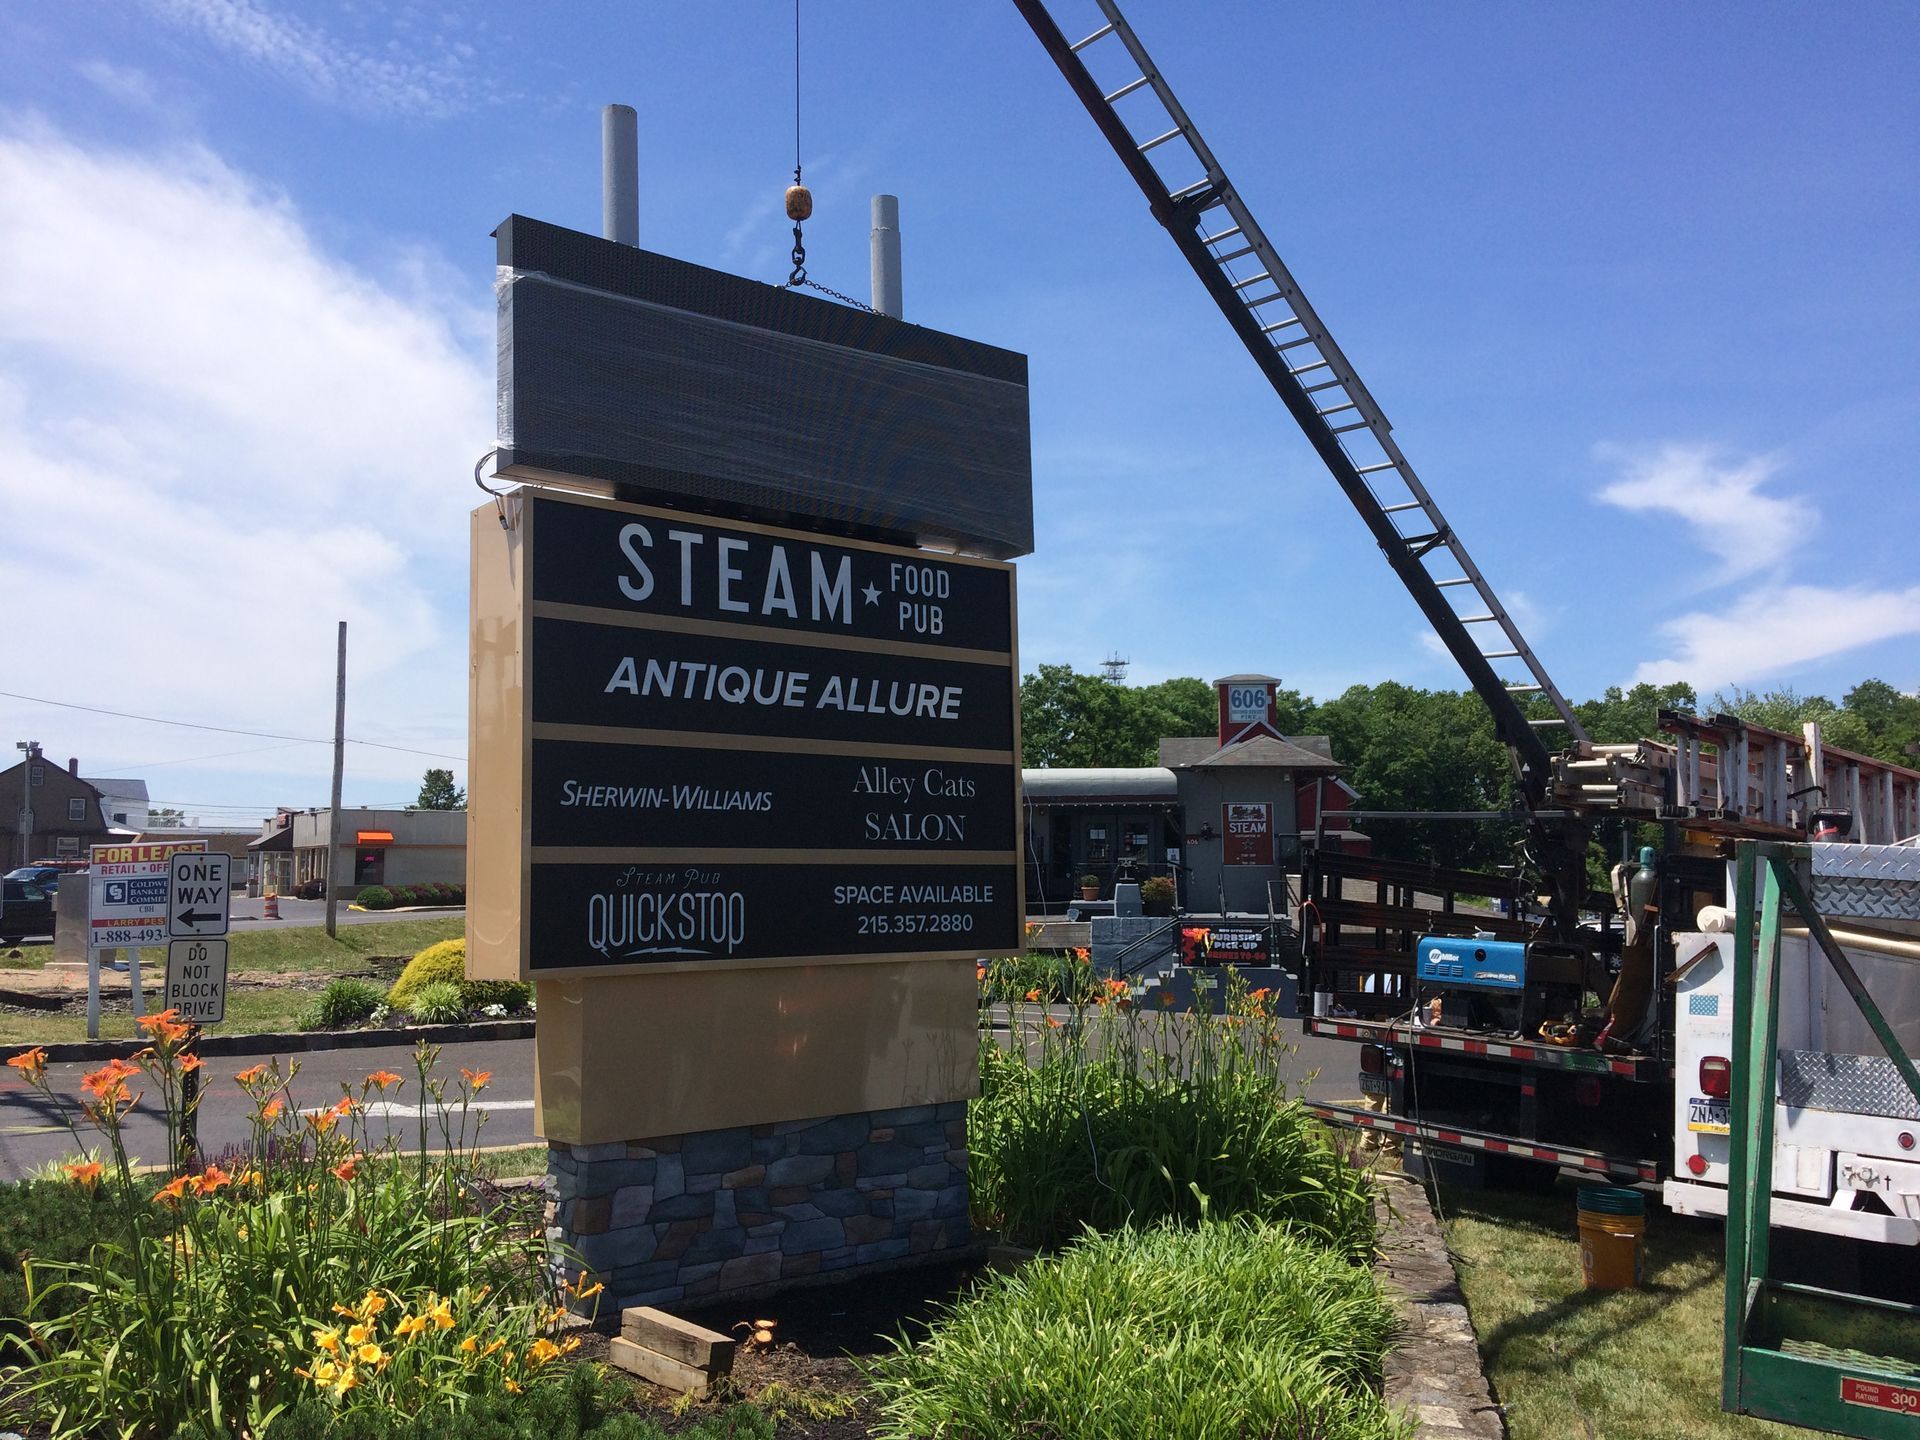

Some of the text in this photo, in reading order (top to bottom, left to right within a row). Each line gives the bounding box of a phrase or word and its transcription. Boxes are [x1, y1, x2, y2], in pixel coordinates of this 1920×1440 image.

[618, 522, 853, 625] STEAM
[890, 562, 950, 599] FOOD
[899, 601, 944, 635] PUB
[604, 656, 963, 720] ANTIQUE ALLURE
[1231, 689, 1265, 708] 606
[852, 766, 976, 804] Alley Cats
[560, 779, 773, 812] SHERWIN-WILLIAMS
[865, 812, 966, 841] SALON
[1229, 822, 1267, 833] STEAM
[94, 847, 133, 864] FOR
[101, 865, 137, 875] RETAIL
[177, 864, 222, 881] ONE
[616, 866, 721, 889] STEAM PUB
[130, 888, 166, 896] BANKER
[178, 886, 223, 904] WAY
[834, 885, 994, 904] SPACE AVAILABLE
[107, 919, 141, 927] LARRY
[588, 892, 745, 959] QUICKSTOP
[858, 914, 973, 934] 215.357.2880
[188, 947, 208, 961] DO
[1214, 941, 1258, 950] PICK-UP
[183, 965, 211, 979] NOT
[172, 983, 219, 998] BLOCK
[173, 1001, 215, 1016] DRIVE
[1856, 1384, 1879, 1394] POUND
[1856, 1392, 1879, 1402] RATING
[1891, 1392, 1918, 1408] 300
